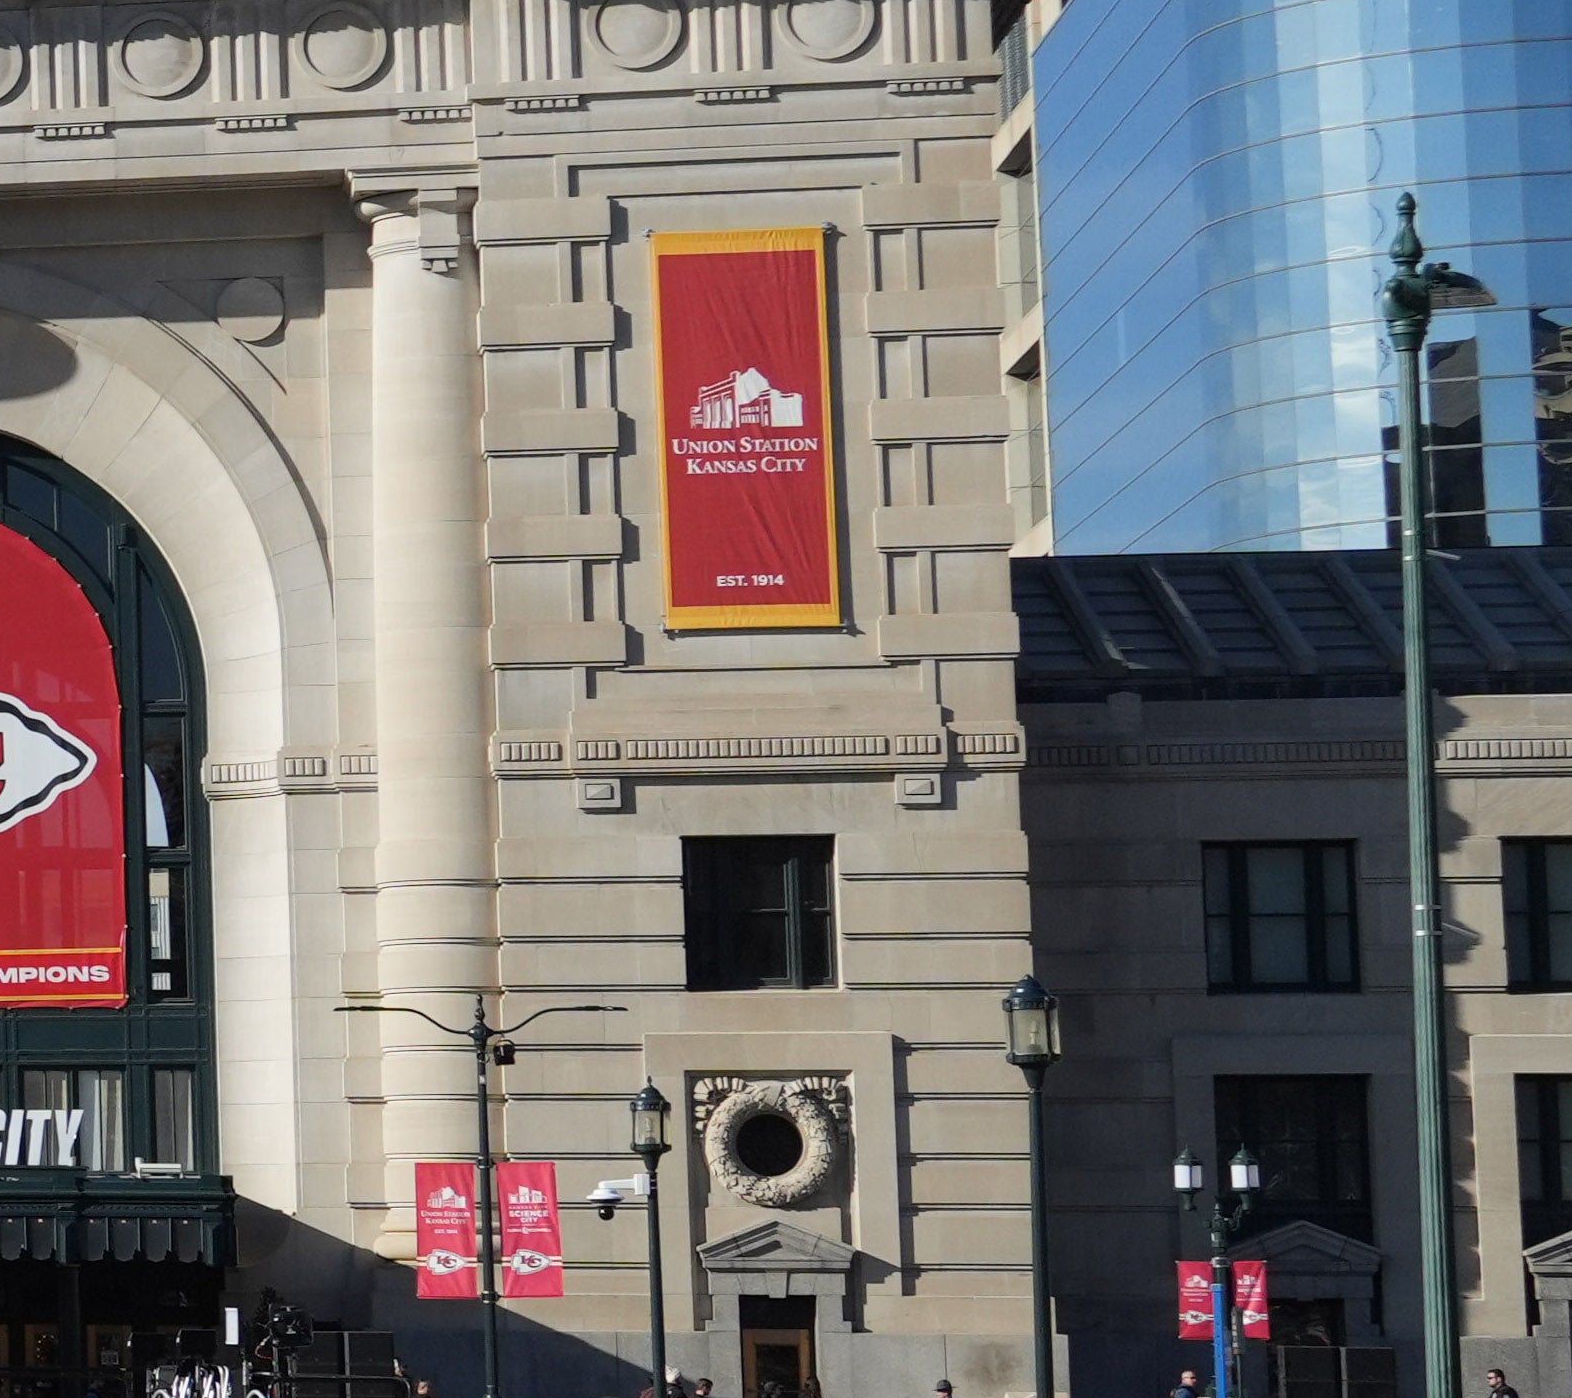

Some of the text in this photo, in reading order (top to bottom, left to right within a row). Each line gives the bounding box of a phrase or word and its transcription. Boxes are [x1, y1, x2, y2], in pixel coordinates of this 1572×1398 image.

[672, 436, 819, 455] UNION STATION
[686, 456, 806, 475] KANSAS CITY
[716, 574, 784, 587] EST. 1914
